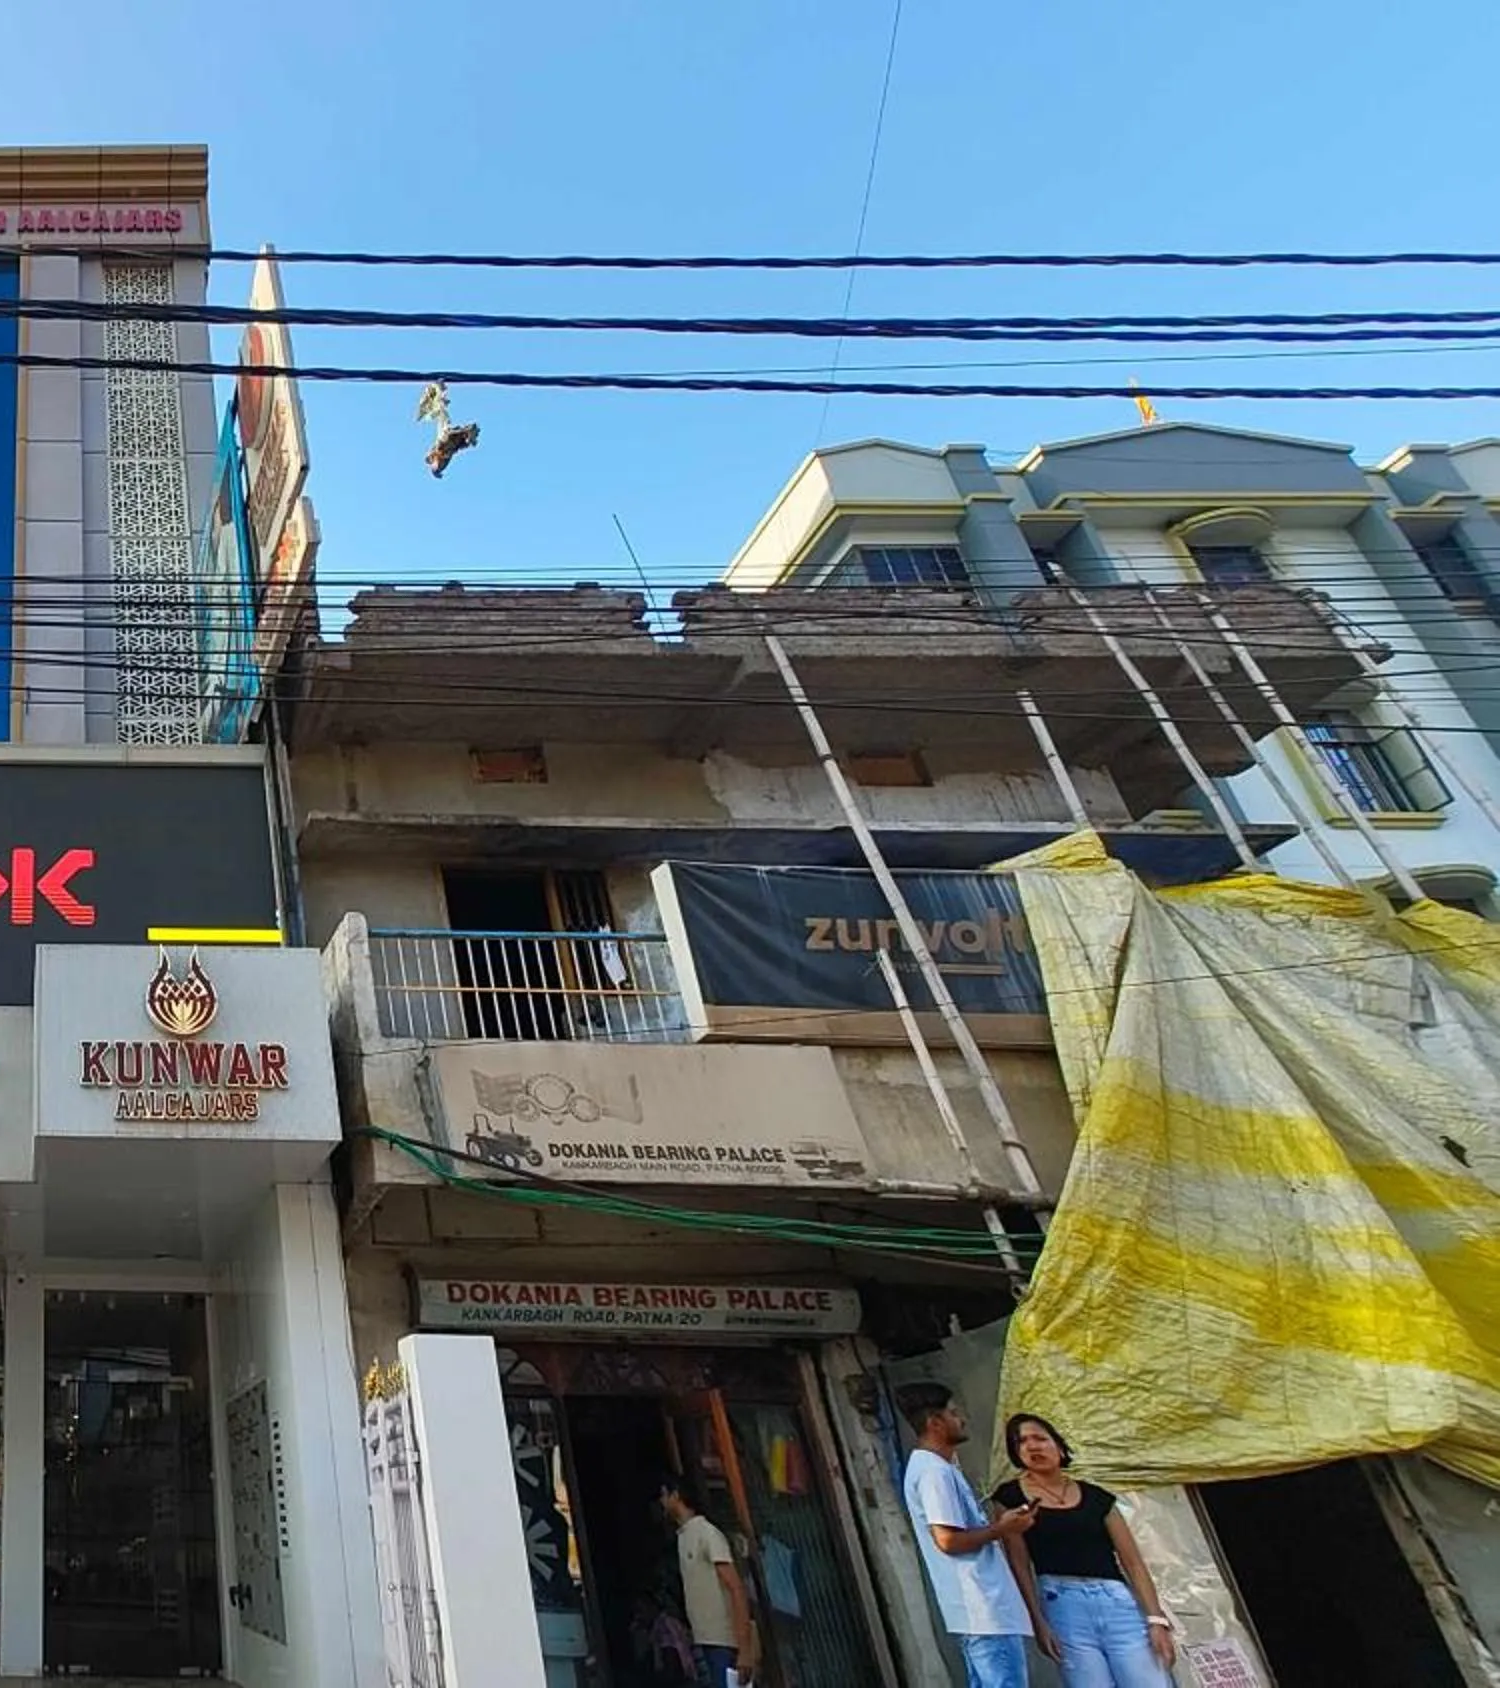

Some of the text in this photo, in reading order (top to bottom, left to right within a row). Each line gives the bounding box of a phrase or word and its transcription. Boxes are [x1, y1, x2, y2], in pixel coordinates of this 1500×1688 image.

[79, 1040, 289, 1089] KUNWAR
[114, 1089, 261, 1121] AALCAJARS
[548, 1143, 787, 1163] DOKANIA BEARING PALACE
[446, 1283, 833, 1312] DOKANIA BEARING PALACE
[461, 1307, 563, 1323] KANKARBAGH
